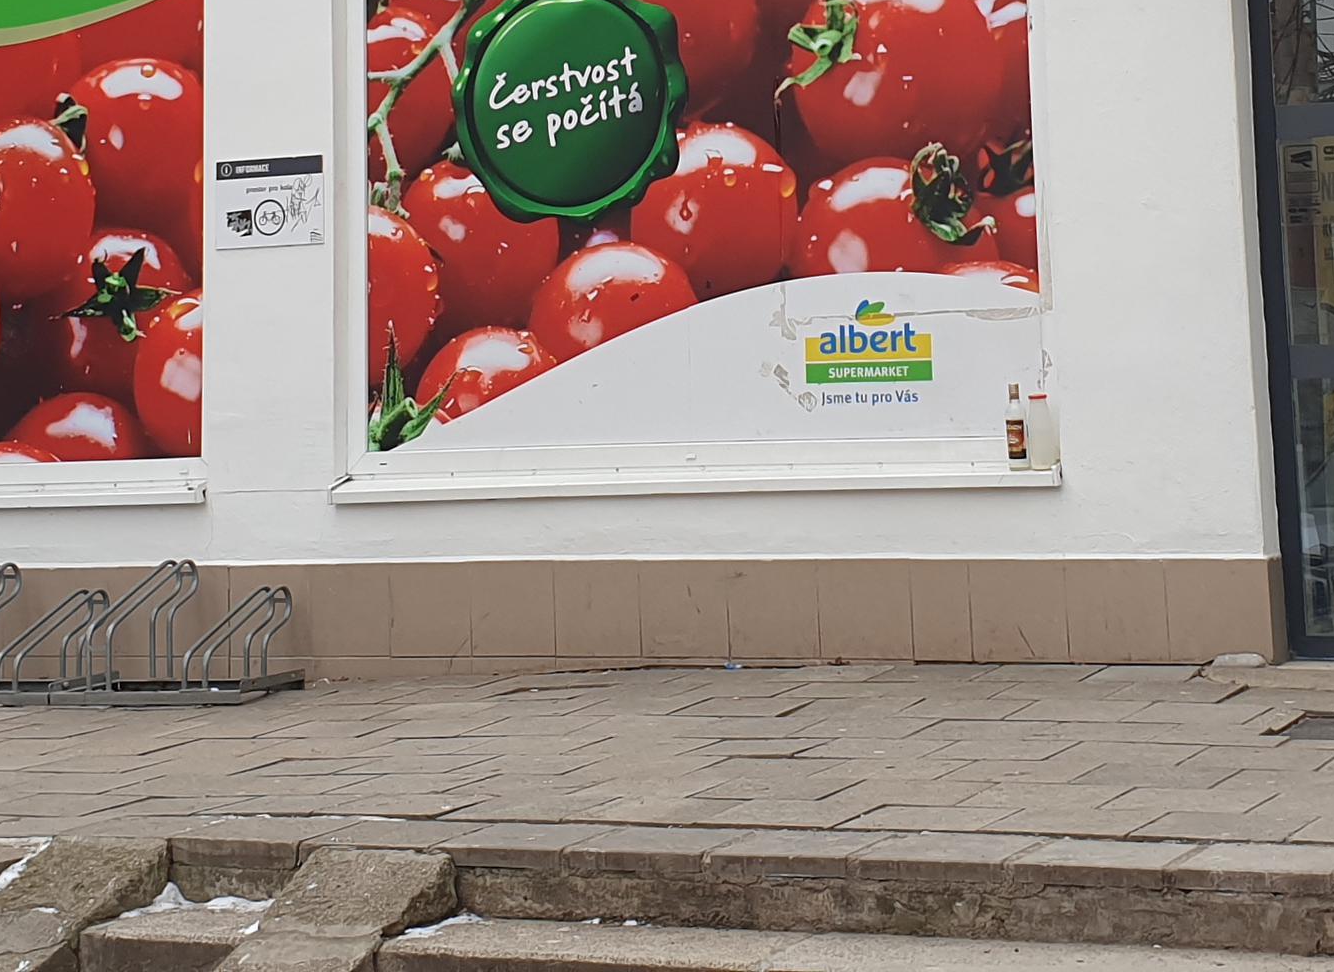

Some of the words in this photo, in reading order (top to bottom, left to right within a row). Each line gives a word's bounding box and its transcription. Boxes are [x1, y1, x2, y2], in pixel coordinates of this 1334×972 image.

[489, 46, 637, 110] Čerstvost
[496, 118, 533, 150] se
[547, 82, 644, 147] počítá
[819, 323, 917, 355] albert
[828, 366, 909, 378] SUPERMARKET
[821, 391, 852, 406] Jsme
[855, 392, 868, 404] tu
[872, 393, 892, 407] pro
[896, 389, 919, 403] Vás
